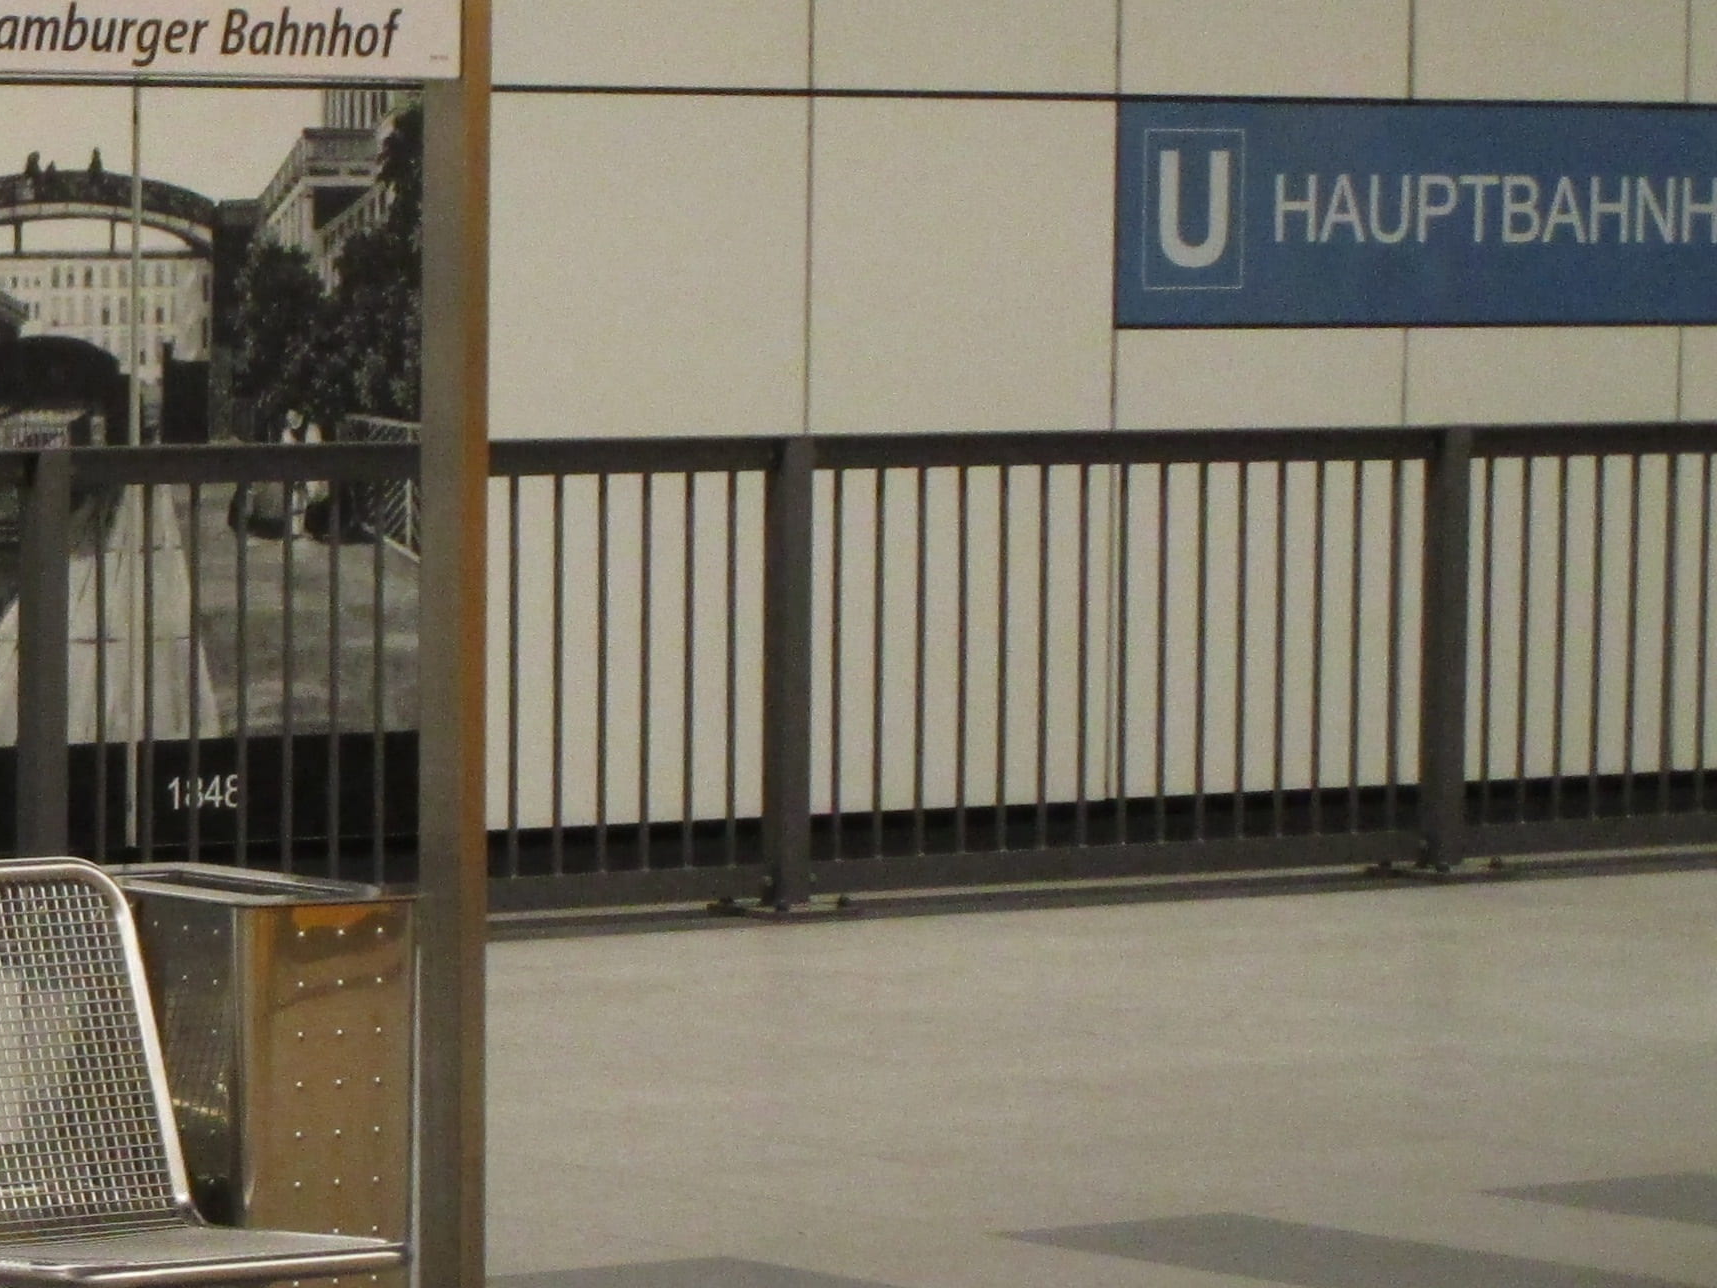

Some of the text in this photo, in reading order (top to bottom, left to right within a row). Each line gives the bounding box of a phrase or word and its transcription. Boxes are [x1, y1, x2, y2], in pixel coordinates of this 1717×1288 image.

[220, 7, 403, 59] Bahnhof
[1159, 149, 1717, 269] U HAUPTBAHNH
